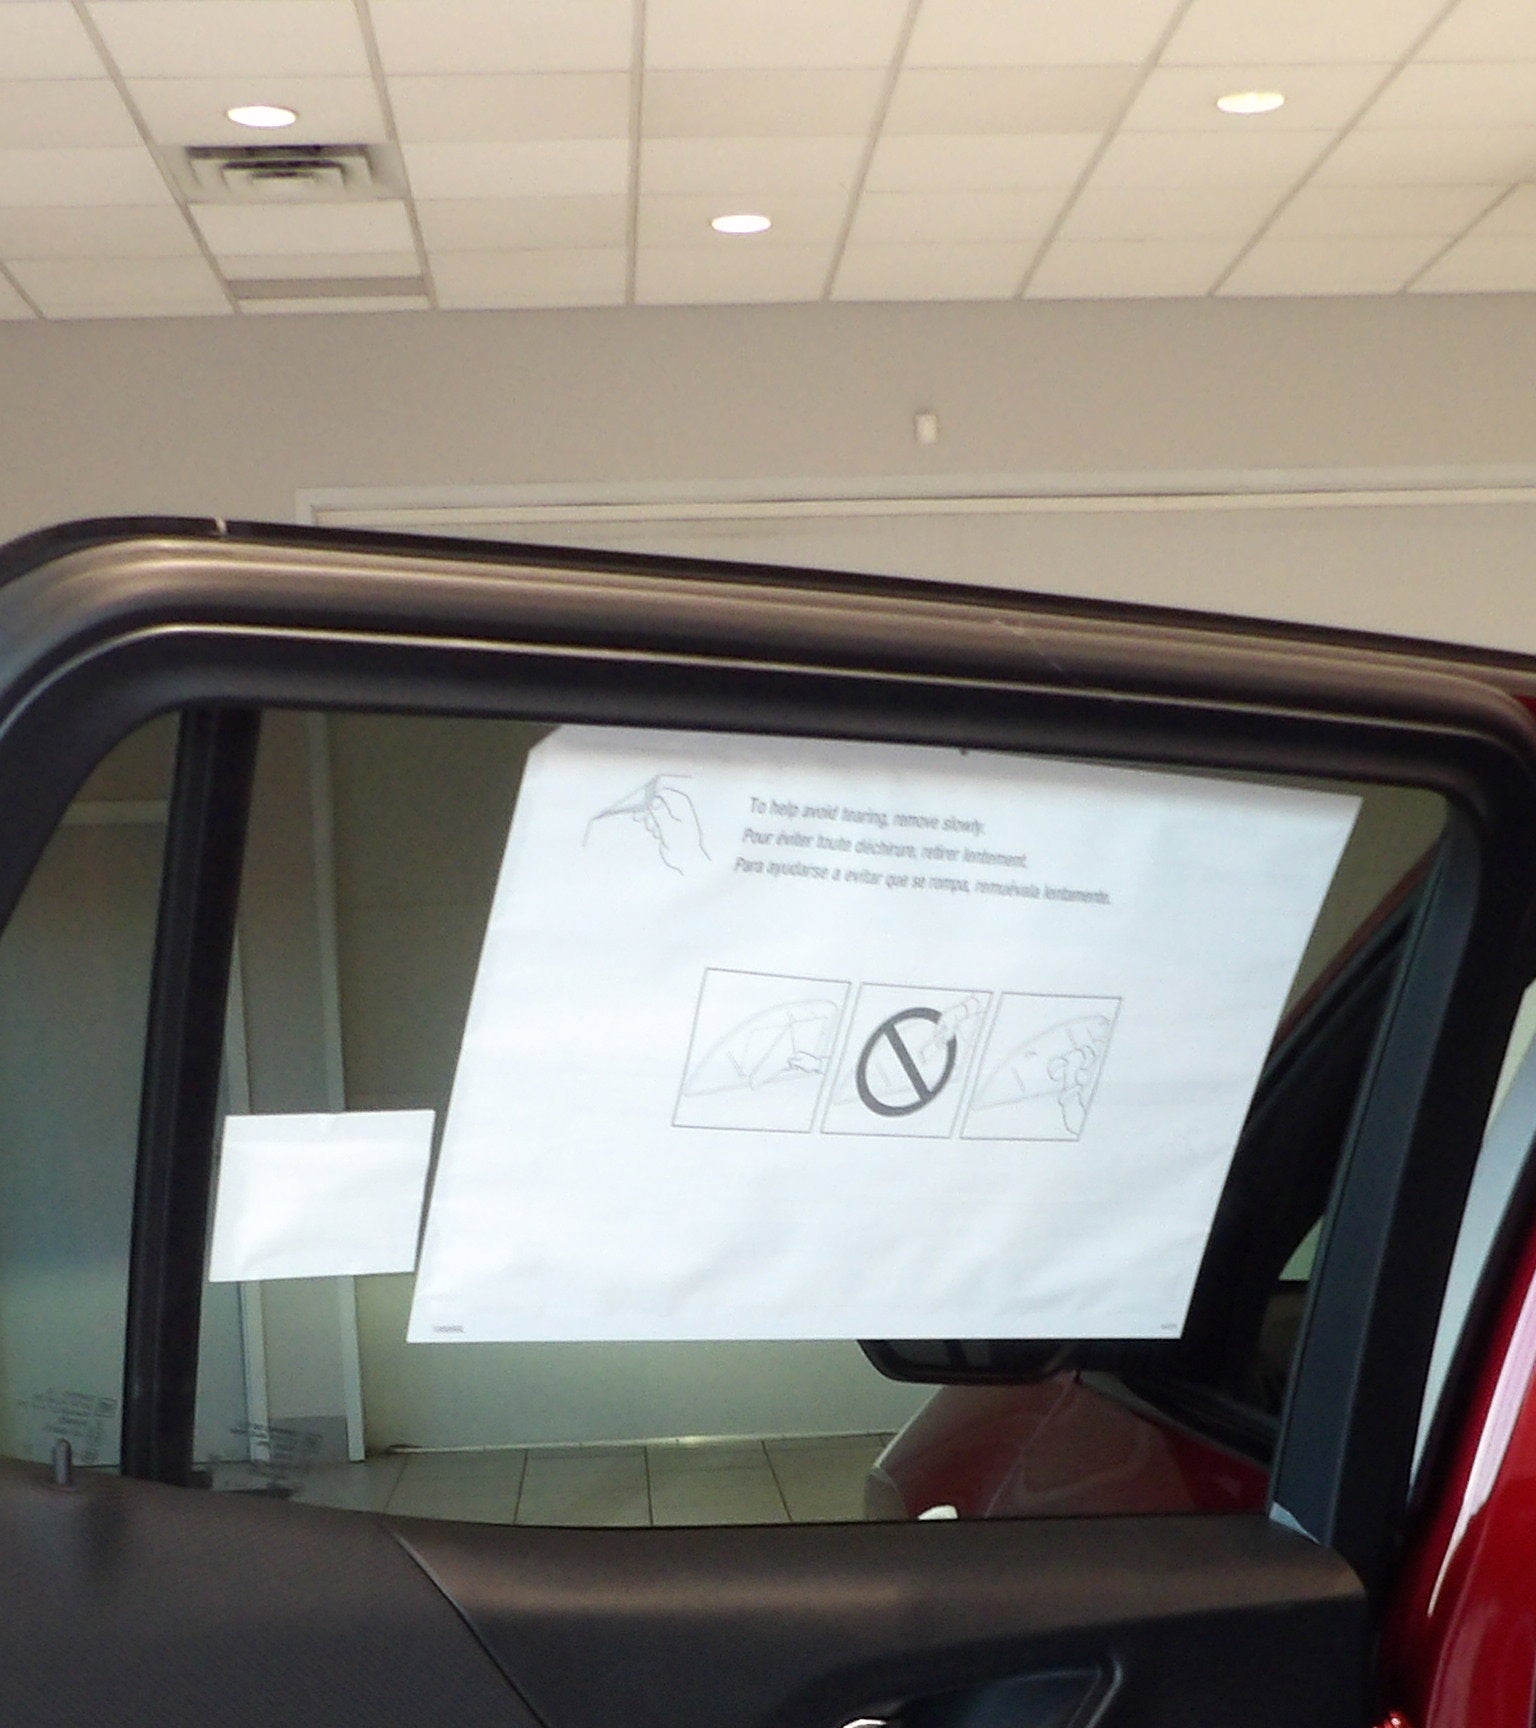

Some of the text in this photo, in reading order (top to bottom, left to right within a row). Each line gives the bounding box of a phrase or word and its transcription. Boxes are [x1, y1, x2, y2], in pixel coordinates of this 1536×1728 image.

[751, 797, 766, 814] To
[769, 800, 799, 818] help
[801, 803, 839, 820] avoid
[893, 813, 939, 830] remove
[742, 828, 774, 845] Pour
[816, 834, 853, 851] toute
[735, 856, 764, 873] Para
[766, 861, 829, 879] ayudarse
[831, 868, 841, 881] a
[844, 869, 883, 885] evitar
[885, 874, 909, 889] que
[911, 875, 926, 888] se
